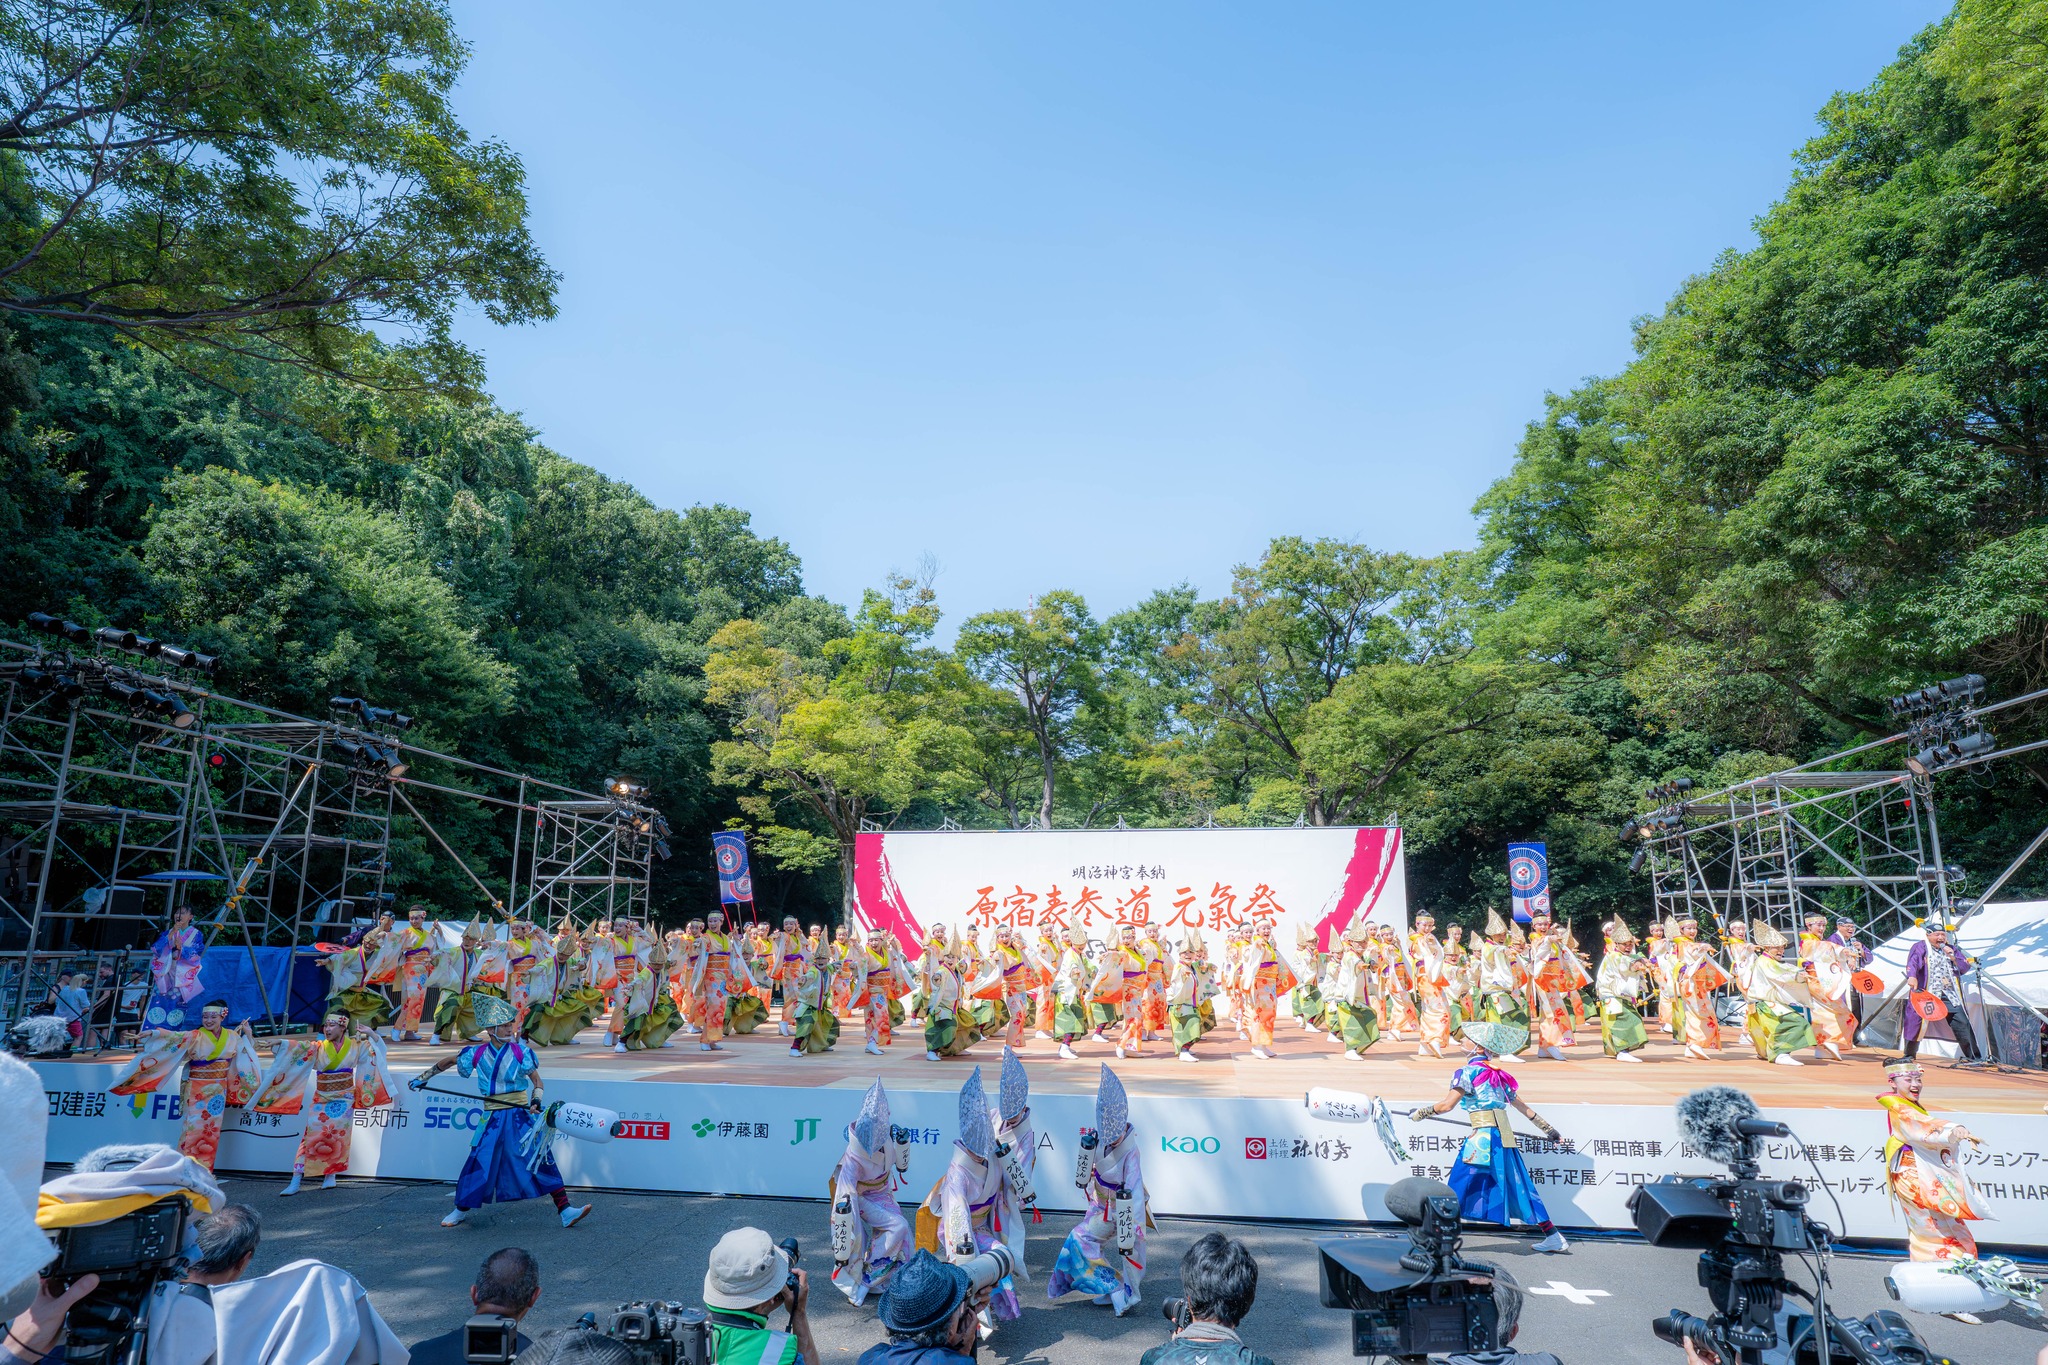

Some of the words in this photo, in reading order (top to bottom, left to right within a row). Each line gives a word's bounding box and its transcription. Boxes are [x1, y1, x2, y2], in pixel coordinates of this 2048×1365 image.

[1071, 865, 1166, 880] 明治神宮奉納
[353, 1107, 410, 1130] 高知市
[424, 1107, 484, 1130] SECO
[717, 1121, 769, 1139] 伊藤園
[790, 1118, 822, 1146] JT
[1125, 1206, 1133, 1239] よんでん
